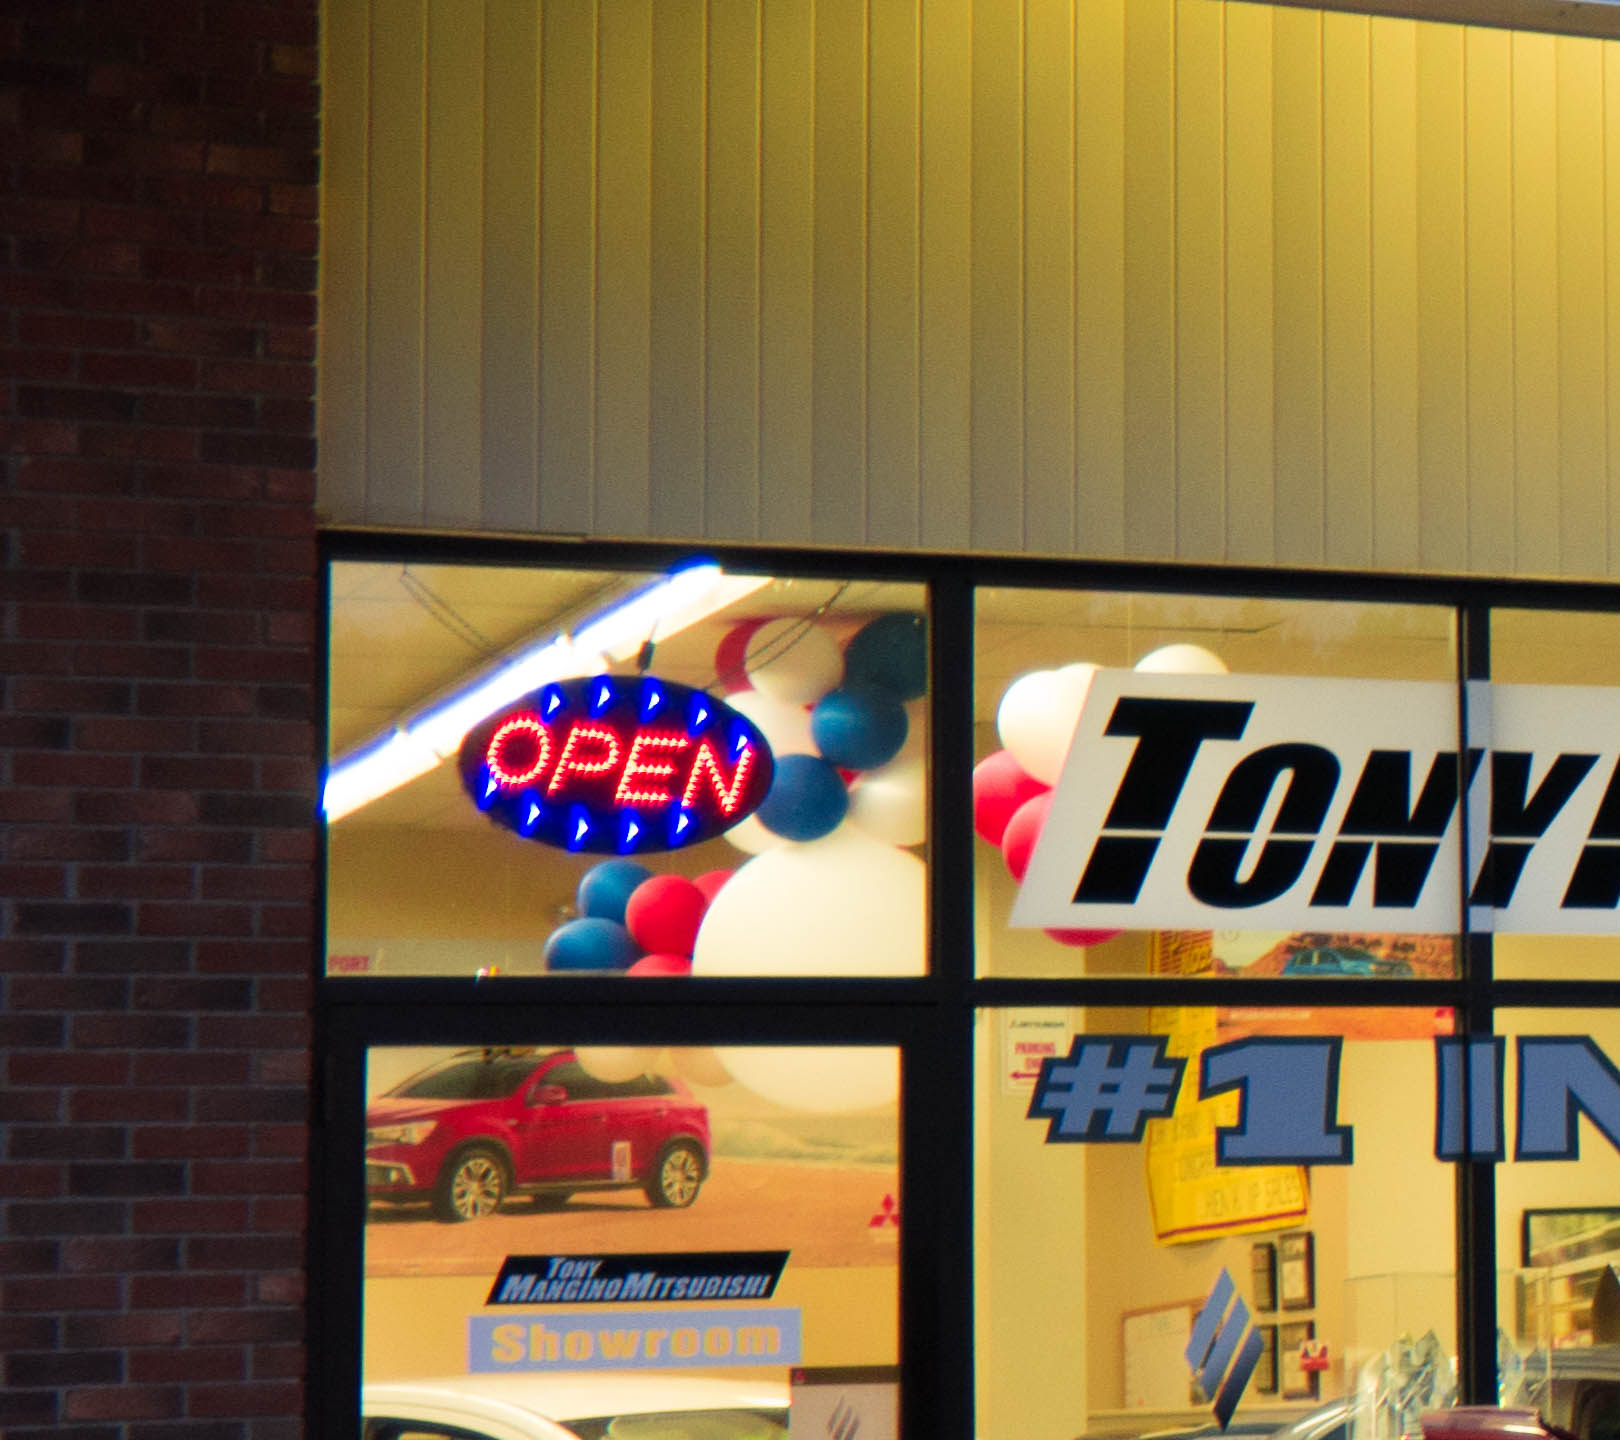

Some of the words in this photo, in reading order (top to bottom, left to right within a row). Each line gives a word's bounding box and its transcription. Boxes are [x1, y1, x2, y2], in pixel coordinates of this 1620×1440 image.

[487, 710, 755, 816] OPEN
[1026, 1034, 1354, 1166] #1
[548, 1257, 602, 1280] TONY
[491, 1322, 782, 1365] Showroom
